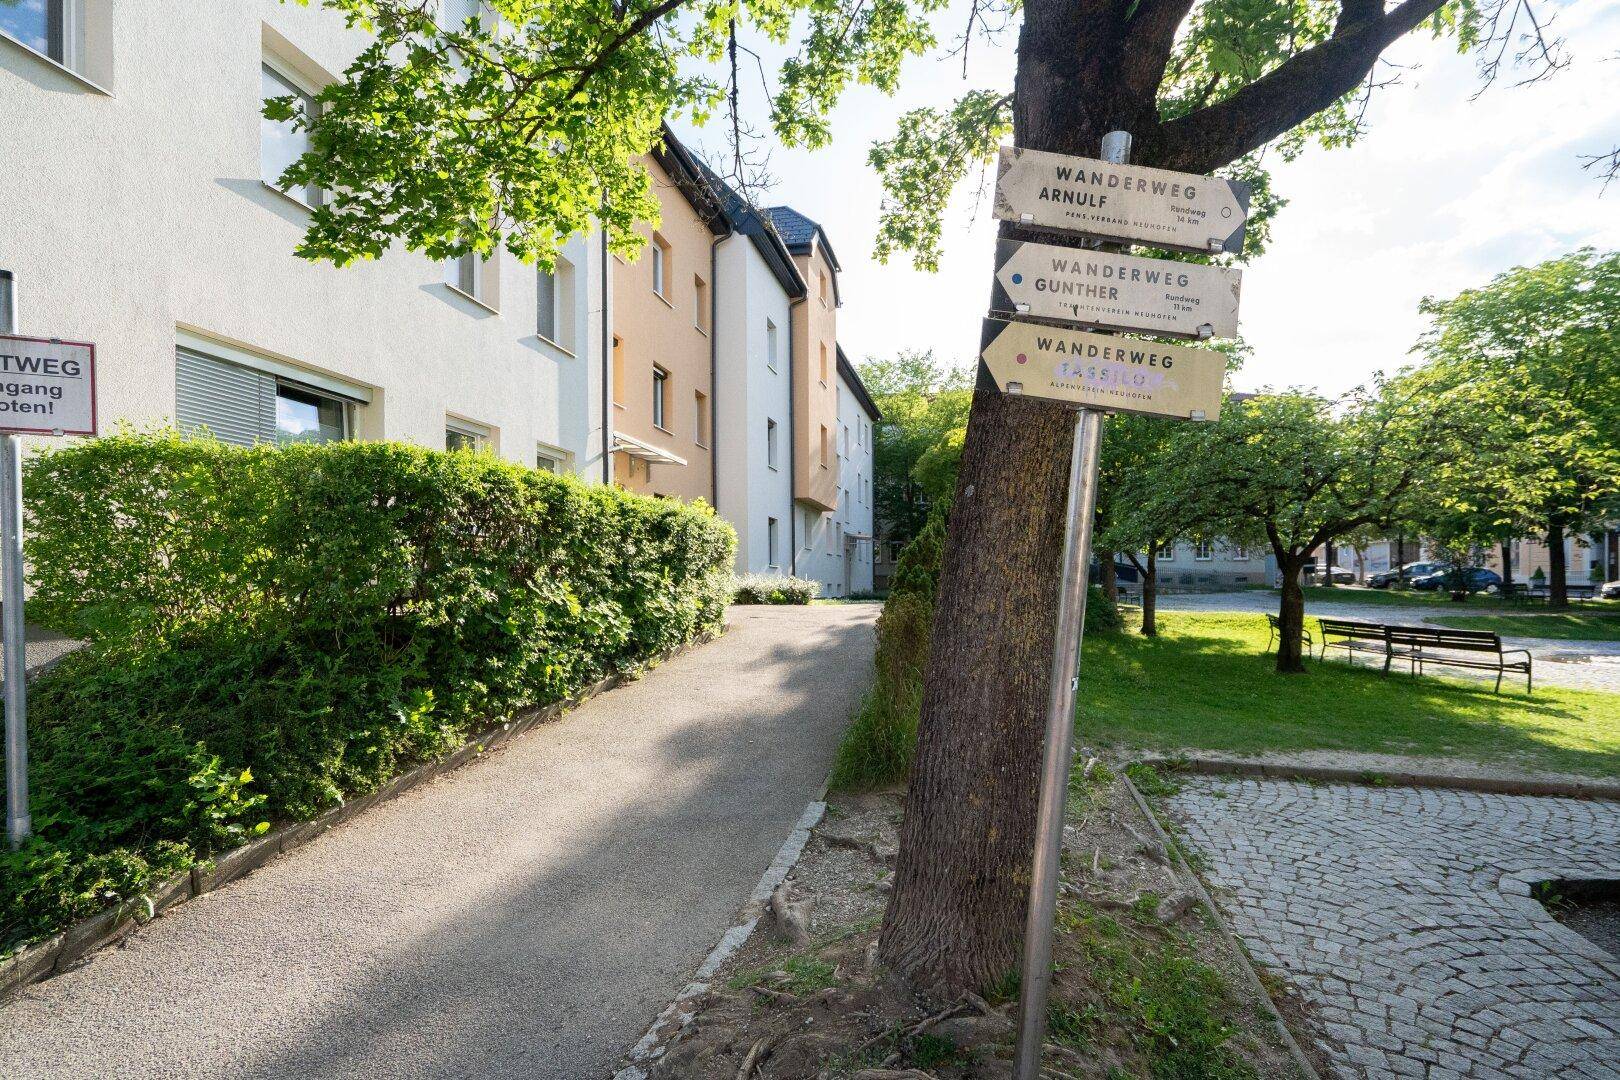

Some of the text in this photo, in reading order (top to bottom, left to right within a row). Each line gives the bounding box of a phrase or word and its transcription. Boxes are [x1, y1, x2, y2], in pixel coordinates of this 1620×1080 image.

[1056, 166, 1197, 200] WANDERWEG
[1039, 187, 1108, 209] ARNULF
[1170, 205, 1206, 218] Rundweg
[1133, 222, 1177, 232] NEUHOFEN
[1187, 216, 1199, 225] km
[1052, 258, 1189, 287] WANDERWEG
[1165, 293, 1200, 305] Rundweg
[1134, 311, 1177, 321] NEUHOFEN
[1181, 304, 1192, 312] km
[1037, 337, 1174, 368] WANDERWEG
[0, 355, 80, 376] TWEG
[1050, 381, 1152, 400] ALPENVEREIN NEUHOFEN
